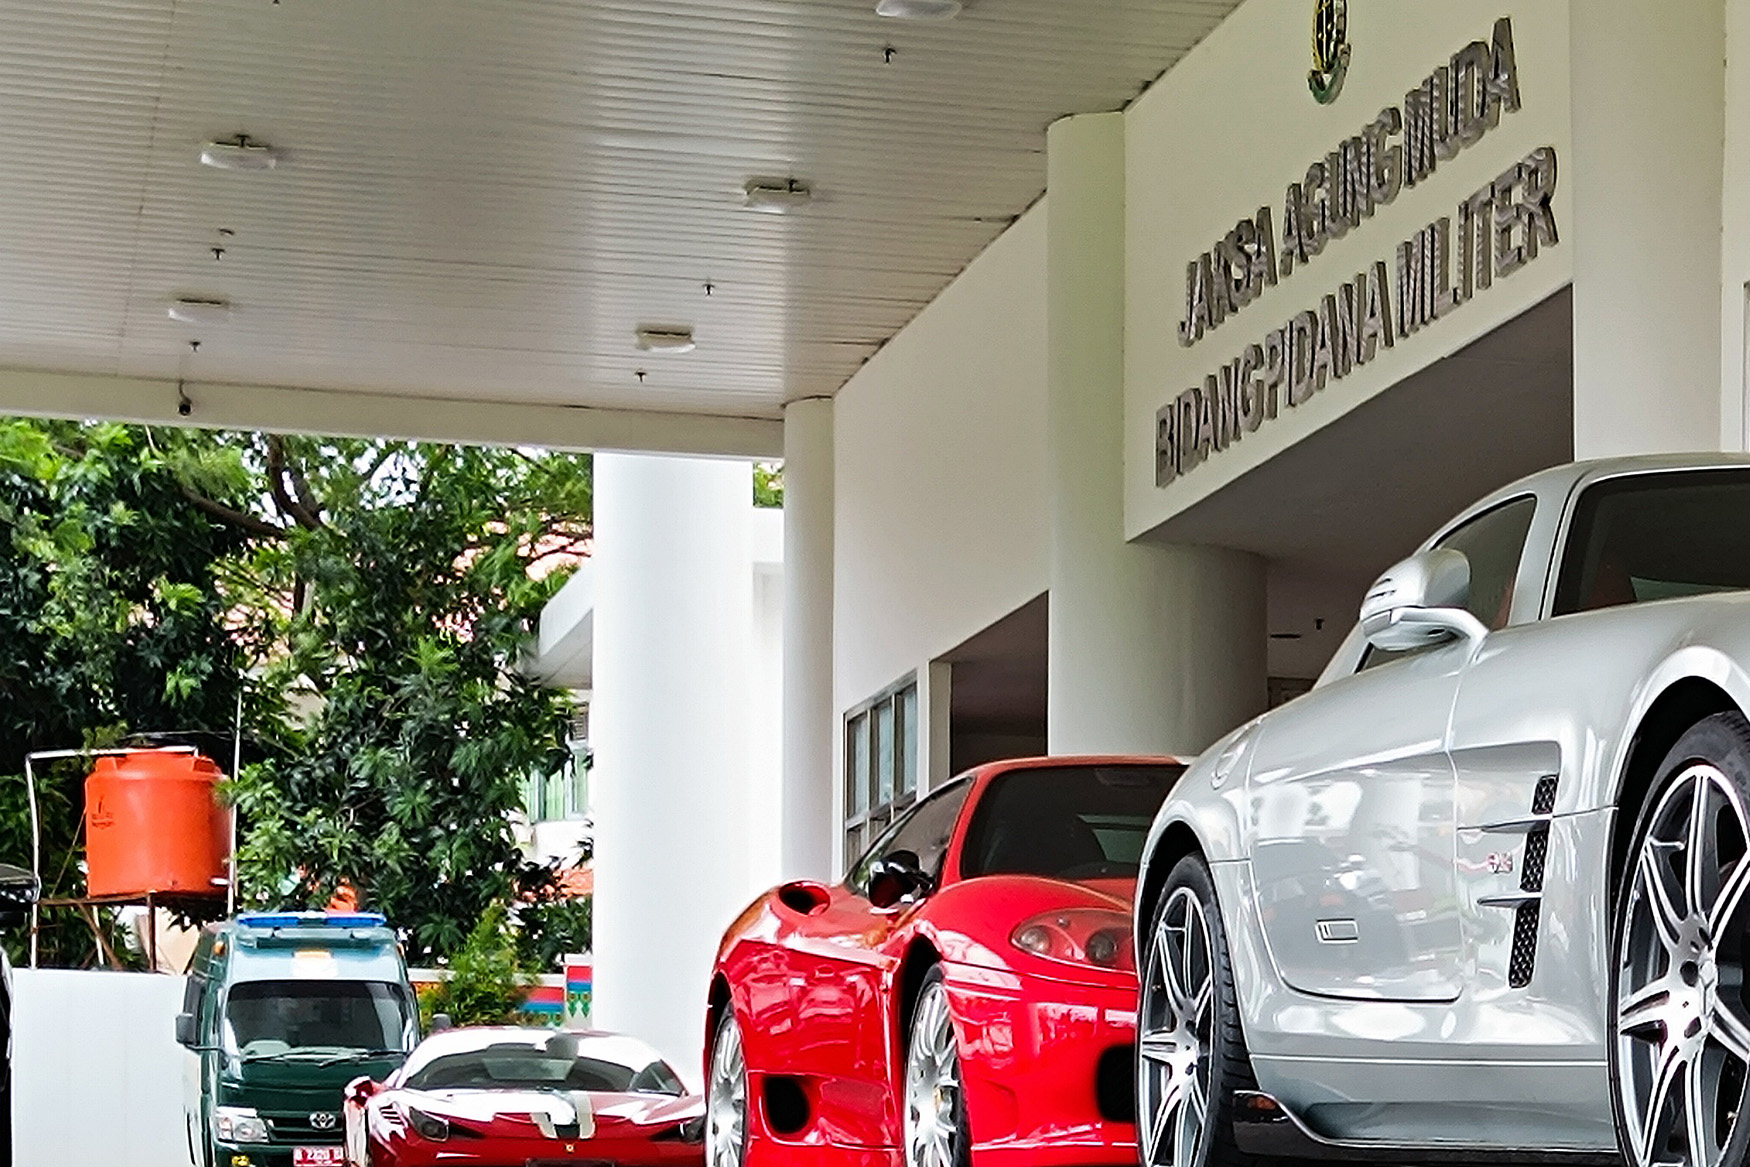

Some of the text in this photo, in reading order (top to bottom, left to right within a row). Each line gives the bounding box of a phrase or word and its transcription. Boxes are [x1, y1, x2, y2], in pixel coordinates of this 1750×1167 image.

[1155, 146, 1559, 488] BIDANG PIDANA MILITER
[1177, 16, 1521, 347] JAKSA AGUNG MUDA
